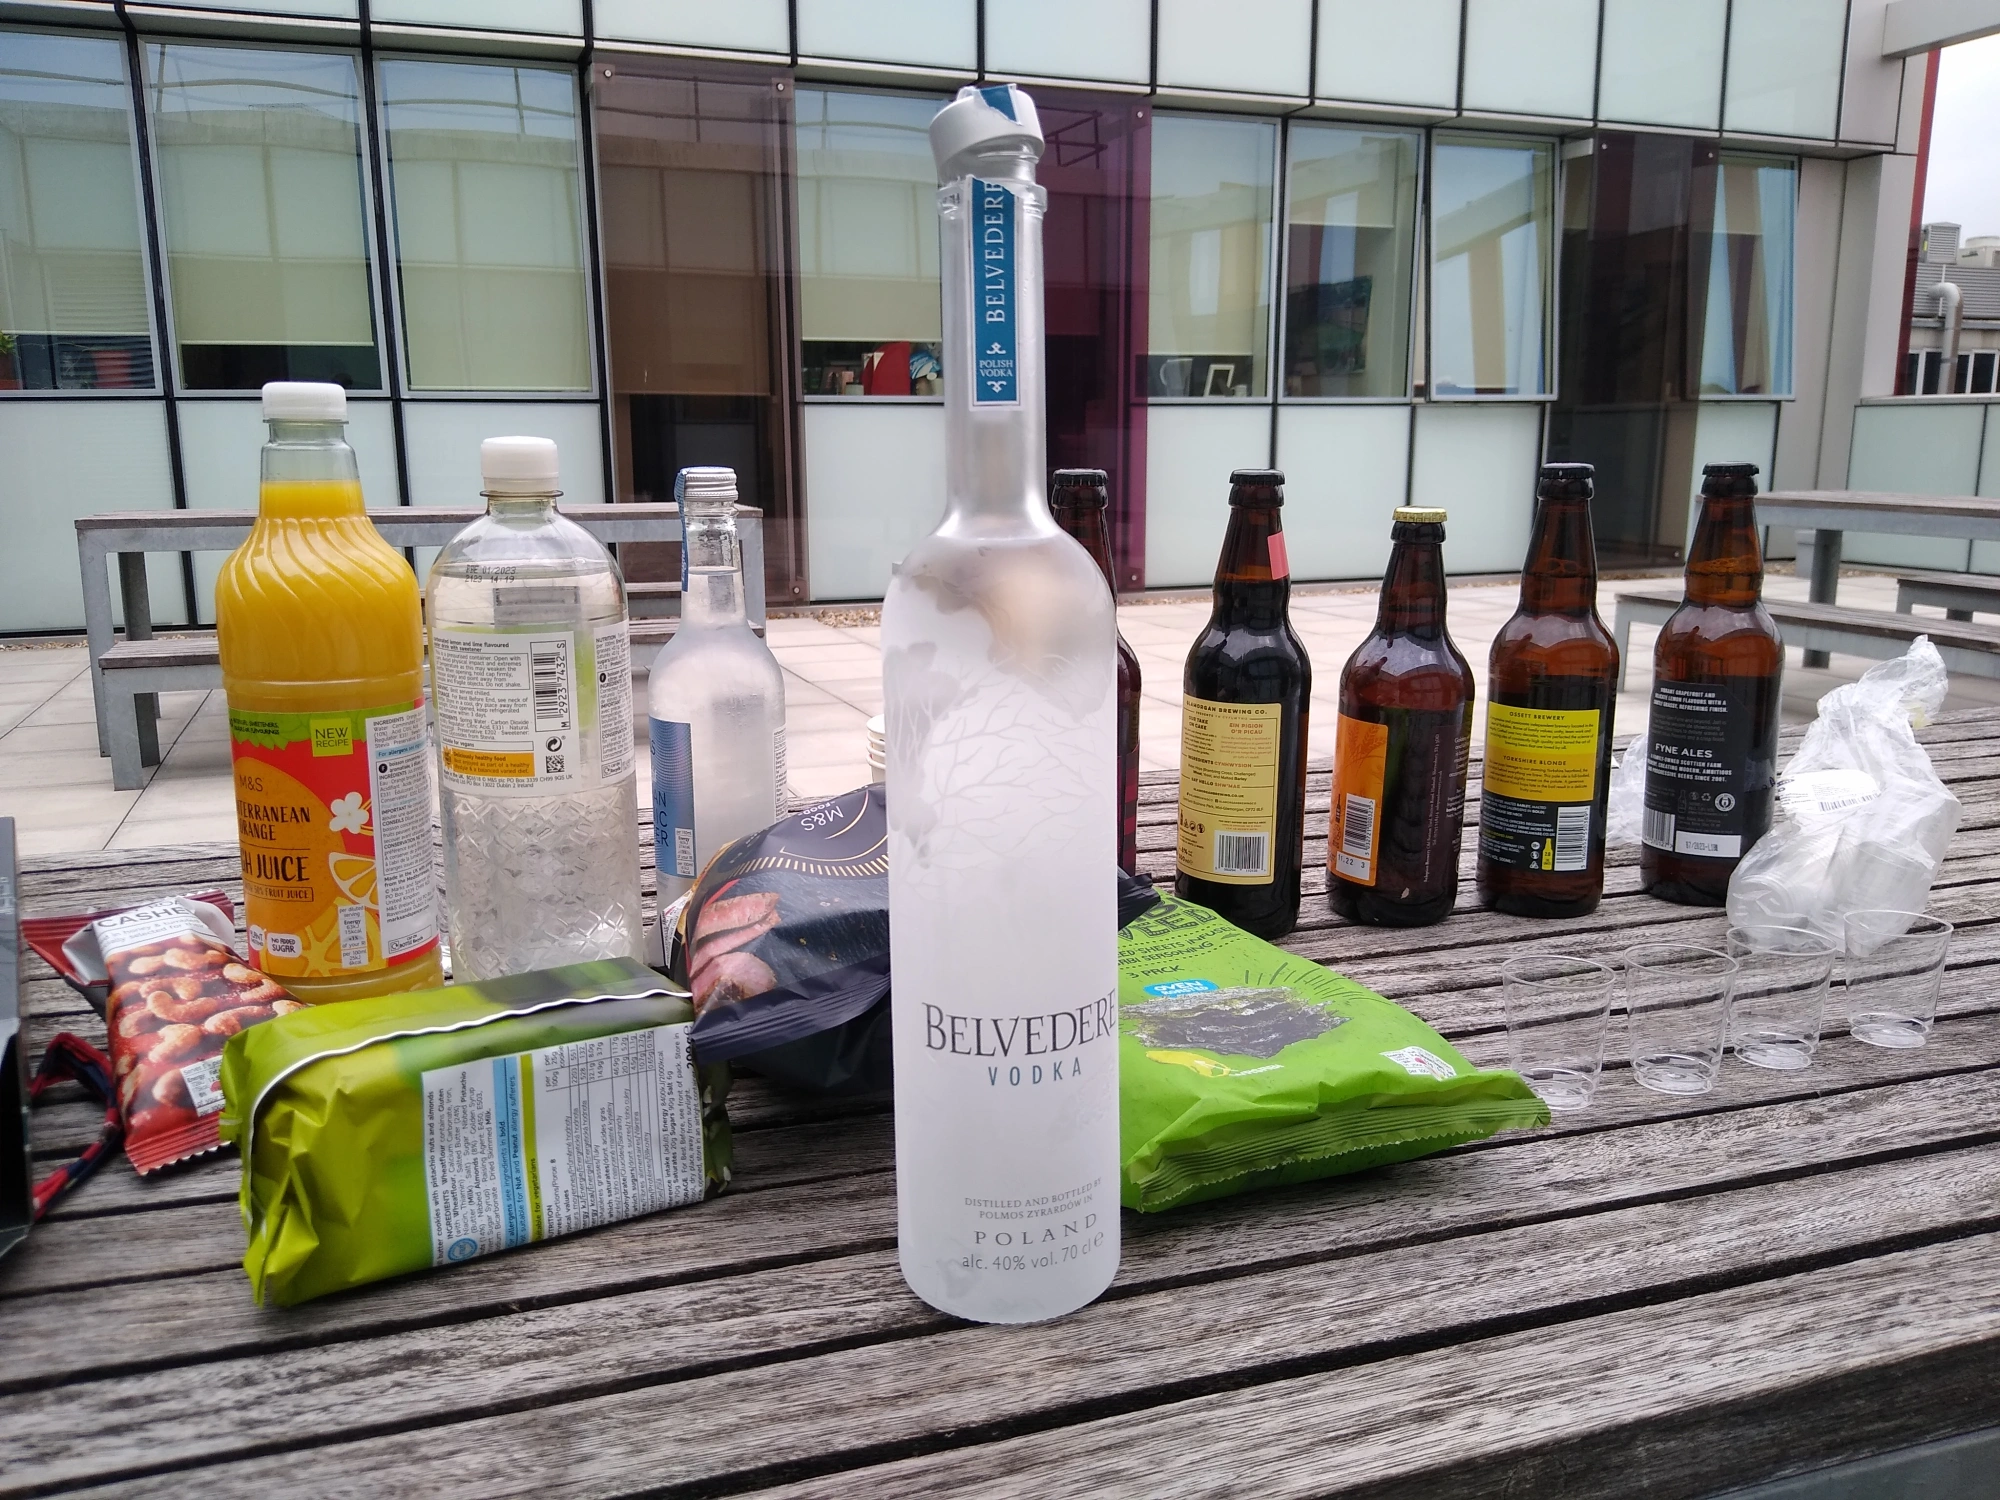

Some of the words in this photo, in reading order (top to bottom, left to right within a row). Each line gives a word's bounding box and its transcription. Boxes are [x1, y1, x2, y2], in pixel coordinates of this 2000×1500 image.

[980, 360, 1014, 368] POLISH
[980, 368, 1013, 377] VODKA
[556, 655, 566, 682] 7432
[558, 687, 568, 714] 2923
[373, 717, 404, 727] INGREDIENTS
[316, 727, 348, 739] NEW
[316, 739, 349, 748] RECIPE
[1503, 755, 1536, 764] YORKSHIRE
[1656, 743, 1678, 754] FYNE
[1681, 748, 1712, 758] ALES
[240, 776, 263, 792] M&S
[801, 806, 844, 831] M&S
[257, 854, 310, 882] JUICE
[265, 888, 284, 897] FRUIT
[287, 890, 309, 899] JUICE
[386, 898, 399, 906] United
[98, 906, 189, 927] CASHE
[123, 926, 152, 934] honey
[129, 927, 166, 939] selected
[272, 944, 295, 953] SUGAR
[1138, 942, 1185, 953] SHEETS
[1141, 941, 1213, 961] SEASONING
[1141, 965, 1185, 976] PACK
[1154, 980, 1203, 991] OVEN
[922, 988, 1116, 1057] BELVEDERE
[988, 1057, 1082, 1086] VODKA
[430, 1155, 439, 1187] pistachio
[472, 1157, 480, 1189] Almonds
[488, 1161, 496, 1180] Dried
[502, 1148, 511, 1187] ingredients
[531, 1158, 540, 1200] vegetarians
[467, 1184, 475, 1205] (Milk)
[965, 1197, 1022, 1208] DISTILLED
[1025, 1196, 1048, 1207] AND
[1051, 1186, 1092, 1203] BOTTLED
[1093, 1177, 1102, 1188] BY
[443, 1189, 453, 1240] INGREDIENTS
[979, 1210, 1024, 1220] POLMOS
[1084, 1194, 1093, 1202] IN
[434, 1208, 442, 1236] cookies
[508, 1204, 516, 1236] allergens
[975, 1214, 1097, 1245] POLAND
[962, 1255, 988, 1270] alc.
[992, 1256, 1025, 1270] 40%
[1031, 1252, 1057, 1268] vol.
[1061, 1244, 1078, 1262] 70
[1082, 1238, 1091, 1258] cl
